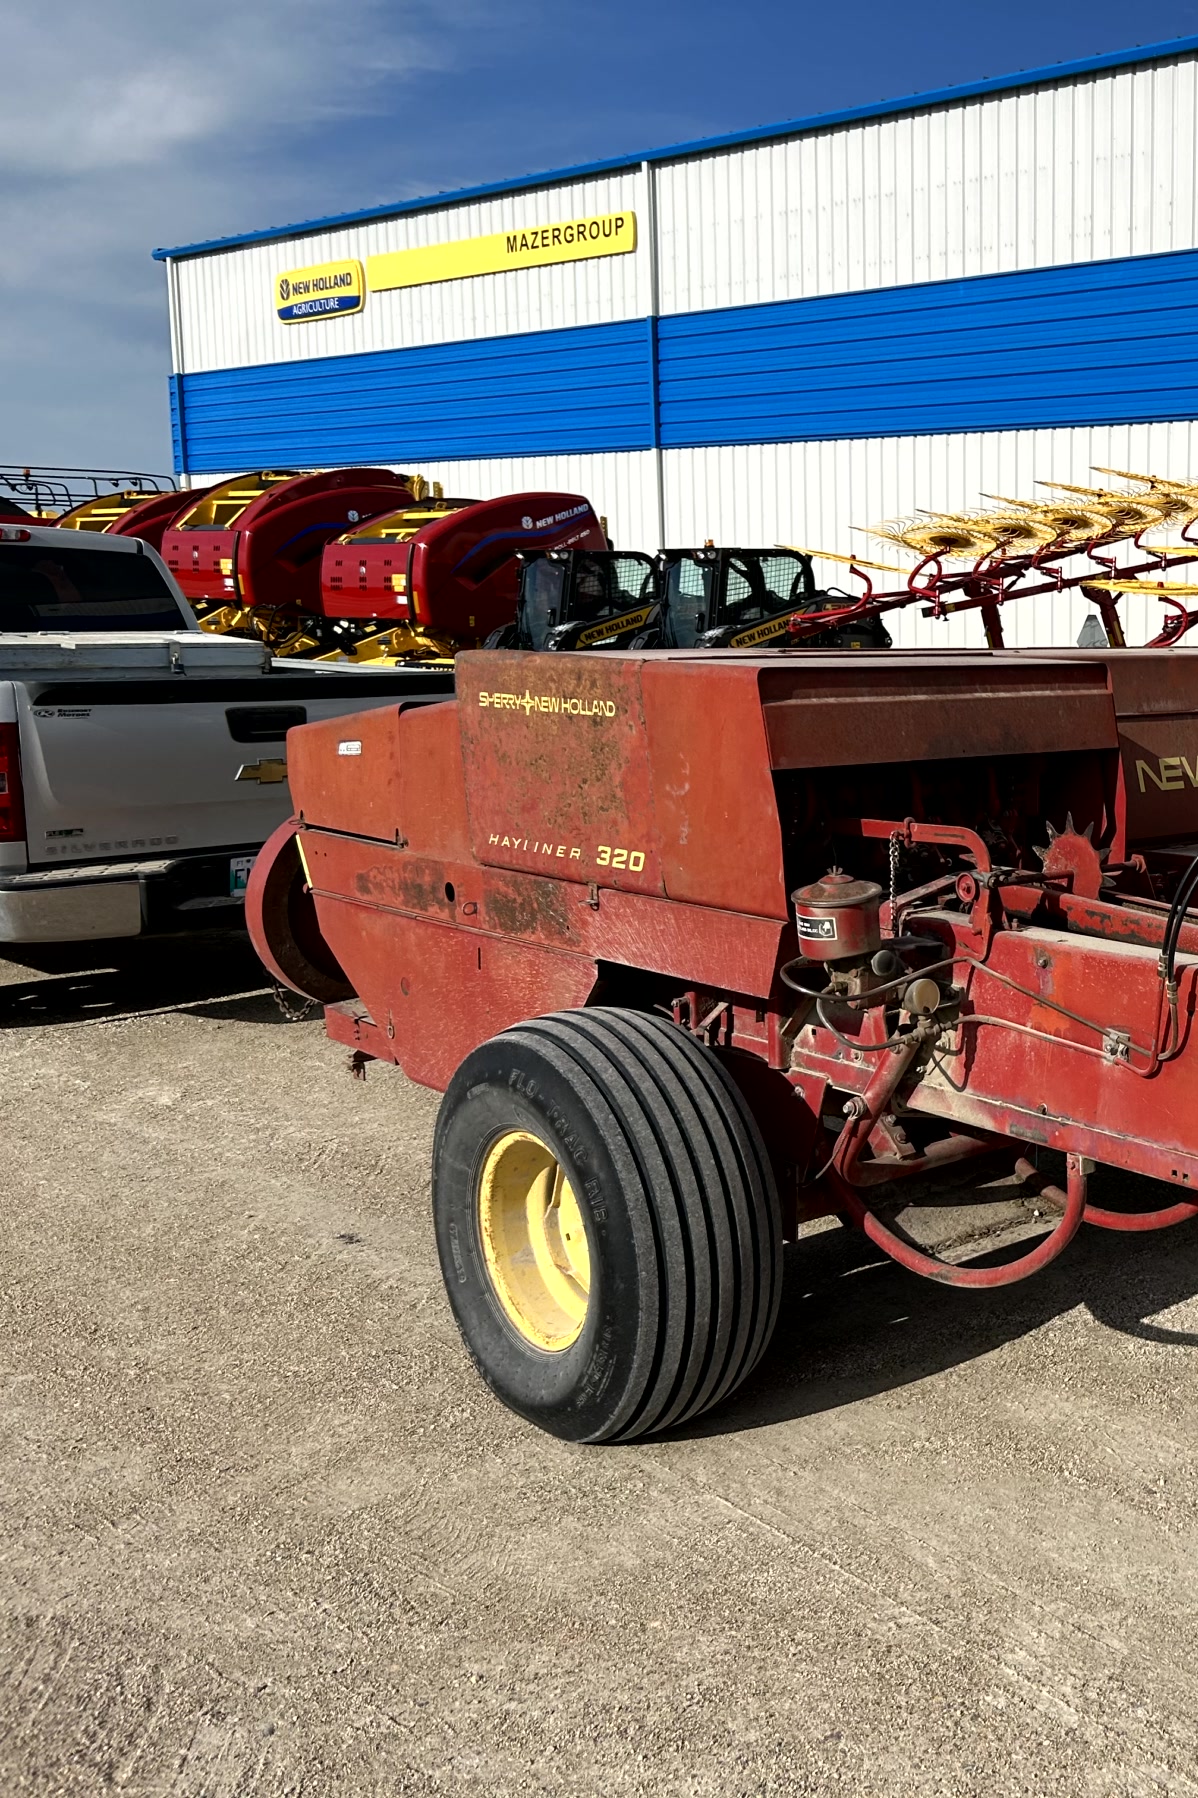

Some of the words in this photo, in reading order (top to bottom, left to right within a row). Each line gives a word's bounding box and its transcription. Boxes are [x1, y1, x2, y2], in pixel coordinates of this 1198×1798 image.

[506, 216, 625, 254] MAZERGROUP
[292, 279, 311, 297] NEW
[312, 272, 353, 293] HOLLAND
[292, 297, 340, 316] AGRICULTURE
[536, 515, 555, 529] NEW
[555, 503, 589, 522] HOLLAND
[584, 627, 605, 642] NEW
[605, 614, 643, 635] HOLLAND
[735, 632, 757, 647] NEW
[757, 618, 790, 640] HOLLAN
[534, 695, 560, 713] NEW
[561, 698, 616, 717] HOLLAND
[45, 834, 179, 856] SILVERADO
[489, 833, 582, 860] HAYLINER
[596, 845, 646, 872] 320
